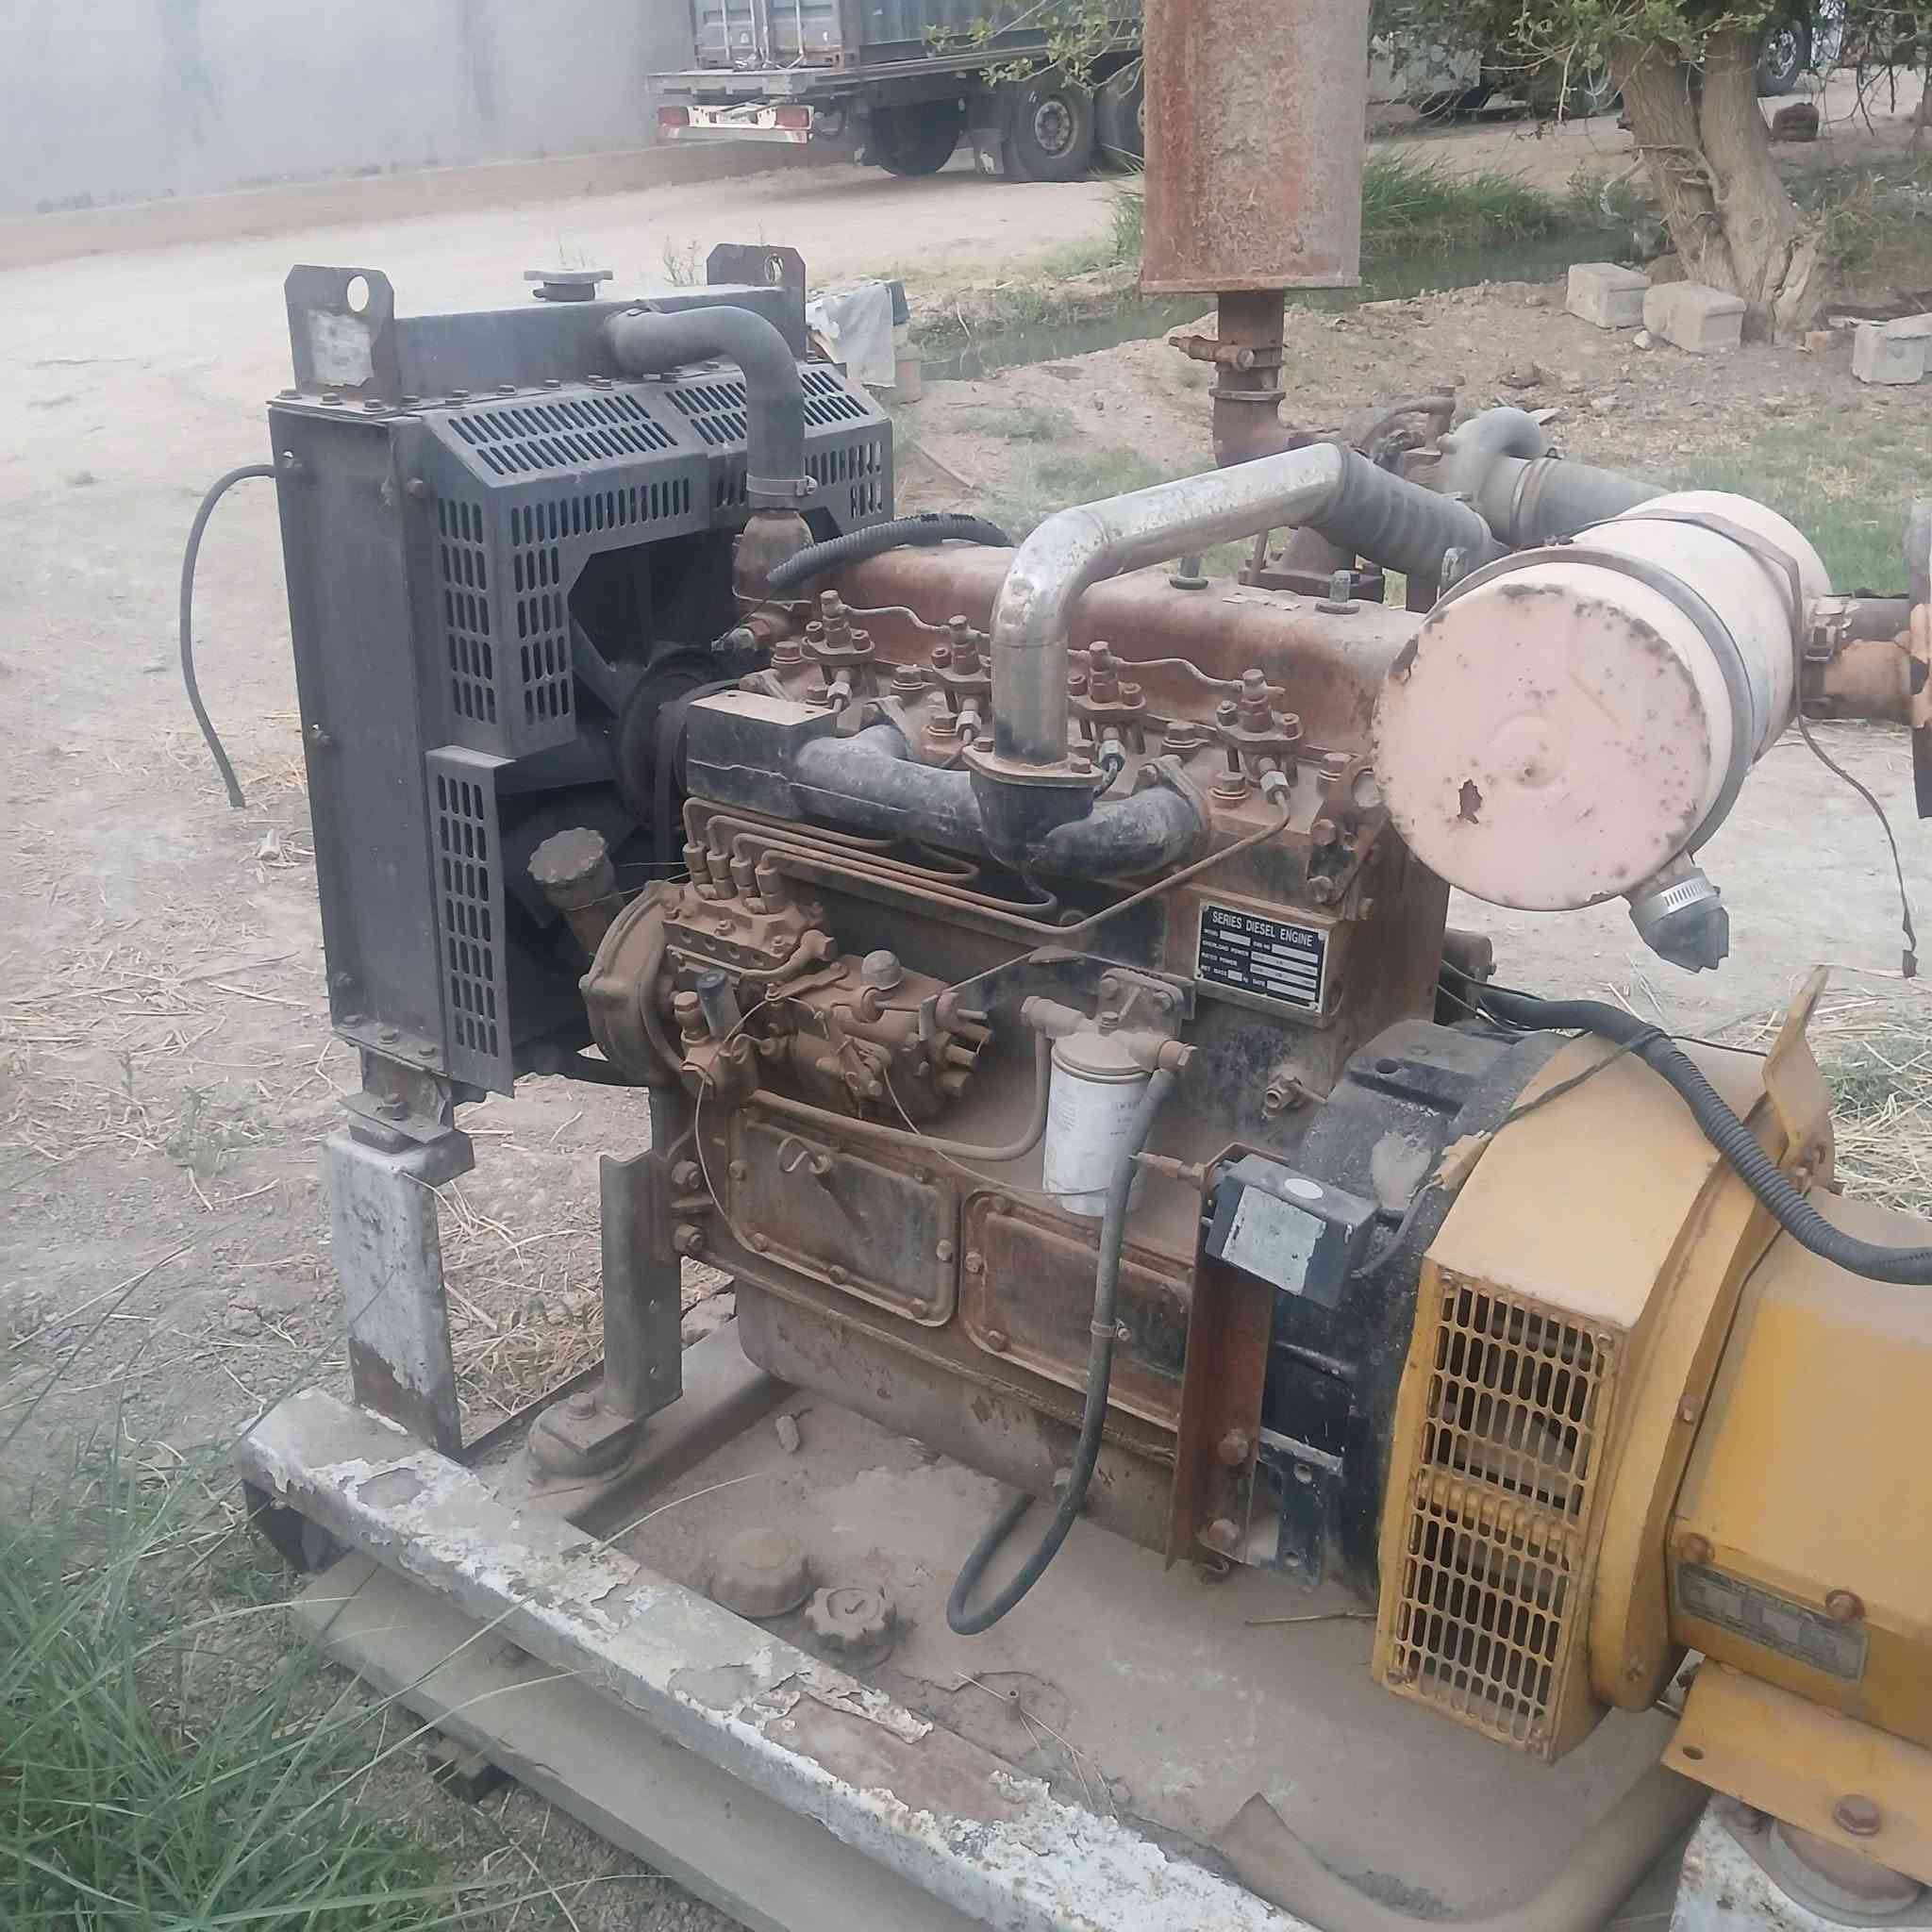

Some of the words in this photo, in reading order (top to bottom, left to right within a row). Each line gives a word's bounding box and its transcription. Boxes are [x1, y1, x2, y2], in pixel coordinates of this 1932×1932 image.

[1212, 911, 1242, 929] SERIES
[1246, 921, 1276, 937] DIESEL
[1280, 928, 1313, 946] ENGINE
[1230, 947, 1249, 957] POWER
[1219, 957, 1238, 966] POWER
